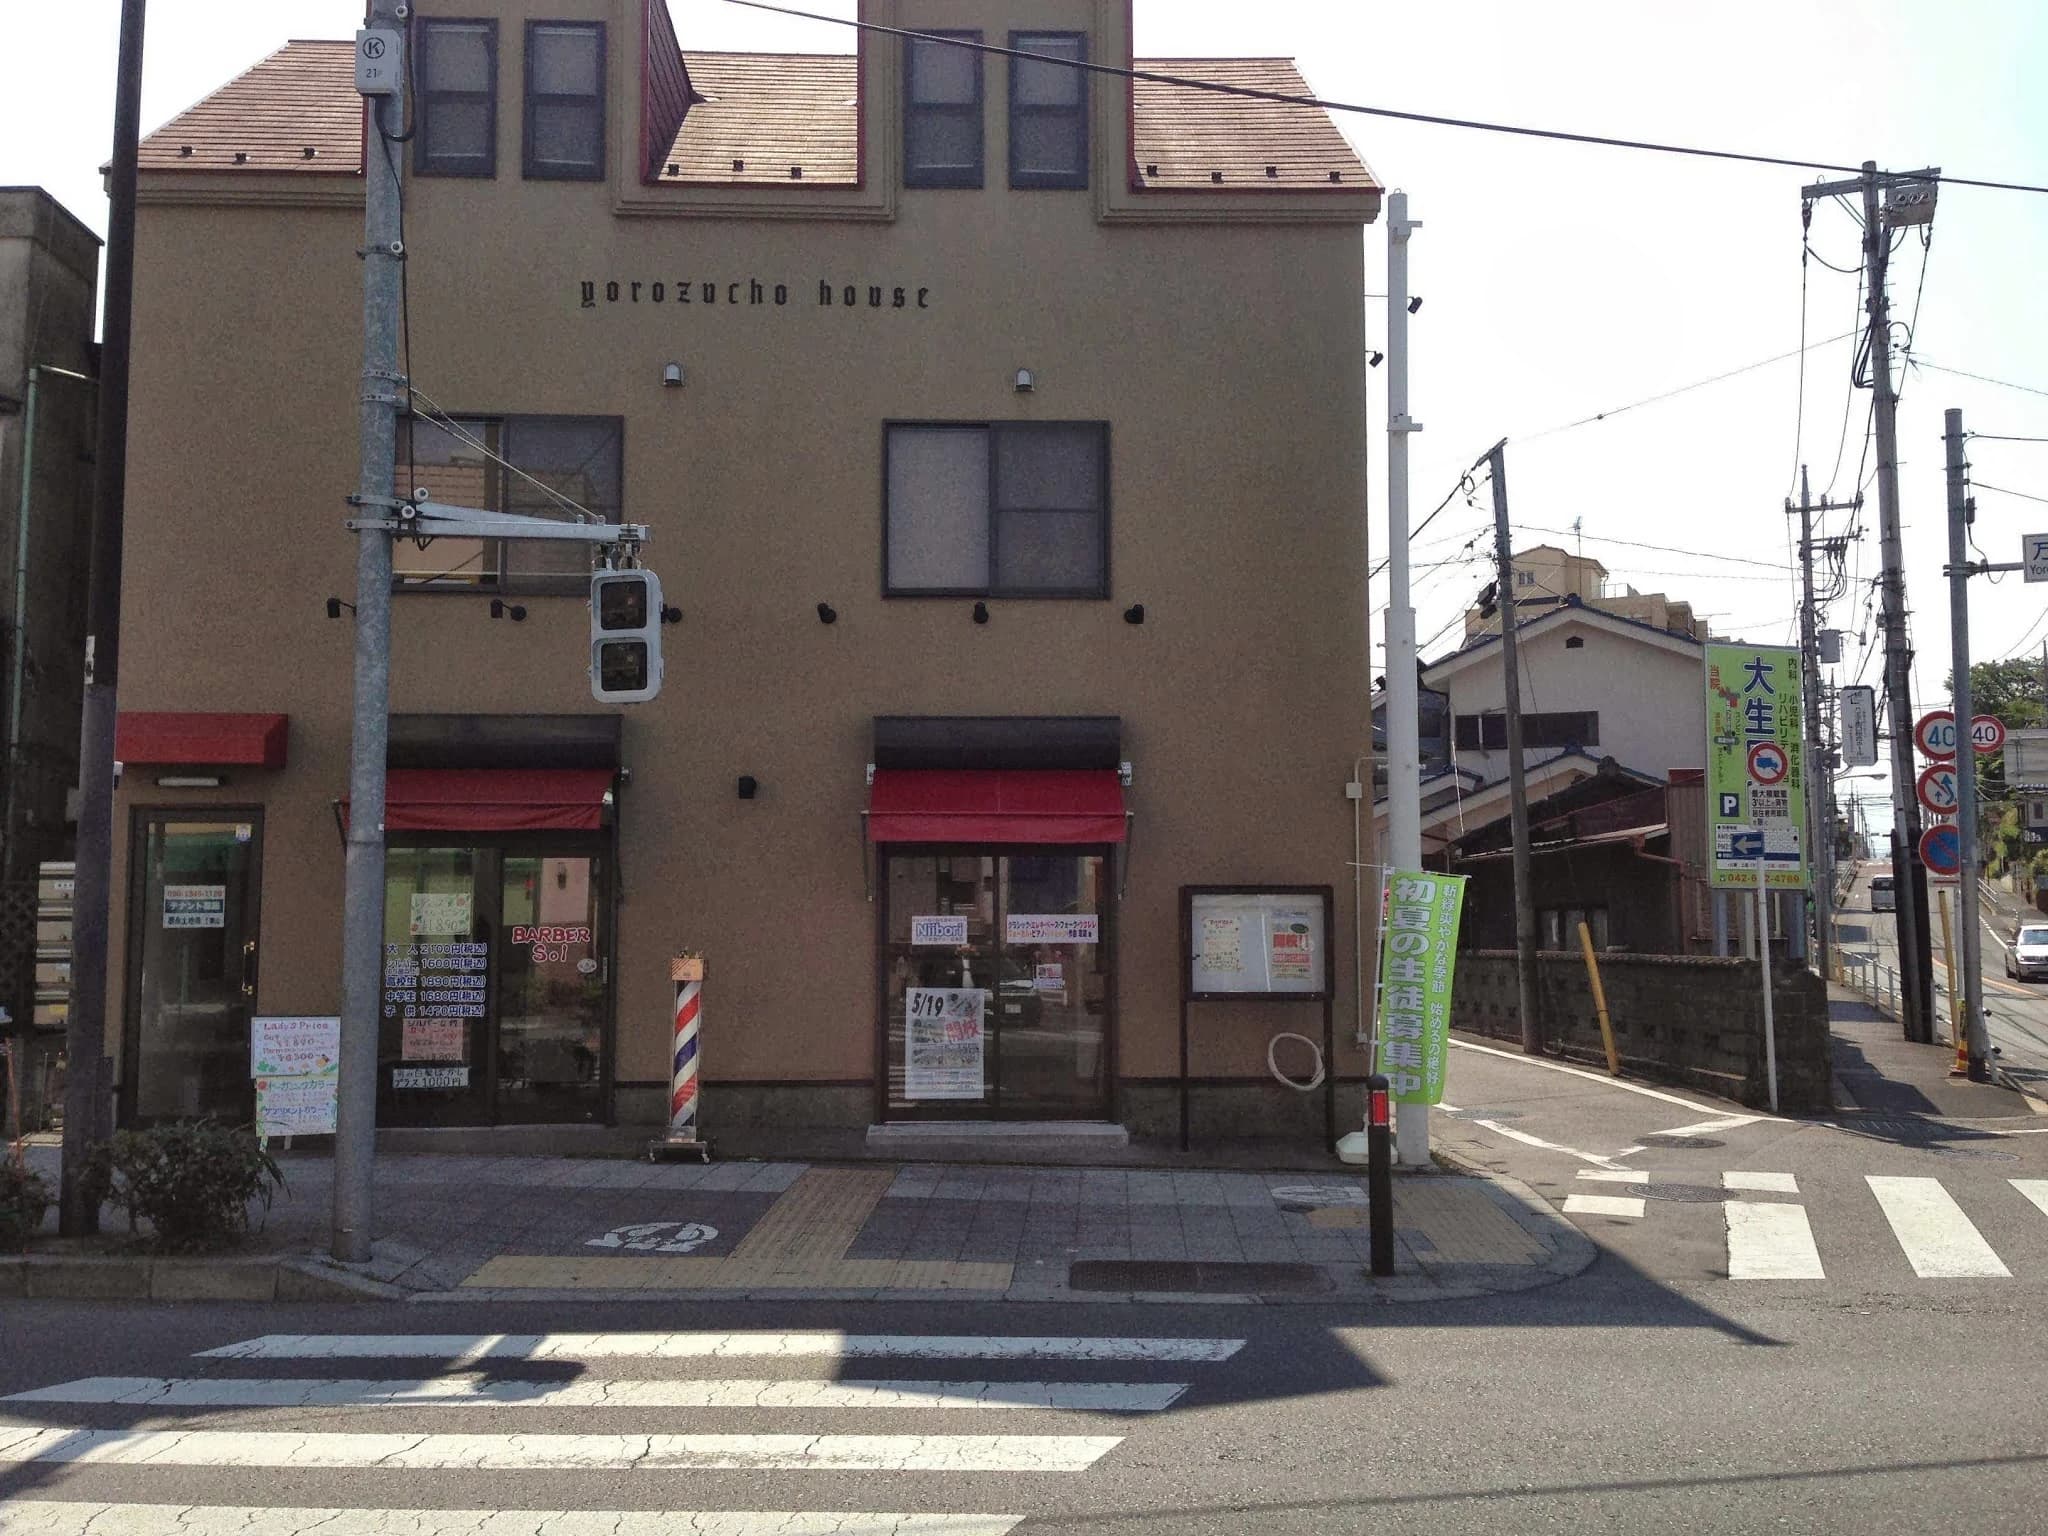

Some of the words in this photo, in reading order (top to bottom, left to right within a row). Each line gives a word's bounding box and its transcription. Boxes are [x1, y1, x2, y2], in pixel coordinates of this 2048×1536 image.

[581, 279, 787, 308] yorozucho
[819, 279, 929, 308] house
[1928, 725, 1955, 747] 40
[1973, 726, 1996, 742] 40
[512, 927, 590, 944] BARBER
[916, 922, 962, 936] Niibori
[532, 944, 568, 962] Sol
[386, 976, 416, 988] 高校生
[1383, 878, 1436, 1096] 初夏の生徒募集中
[385, 990, 416, 1002] 中学生
[912, 993, 944, 1017] 5/19
